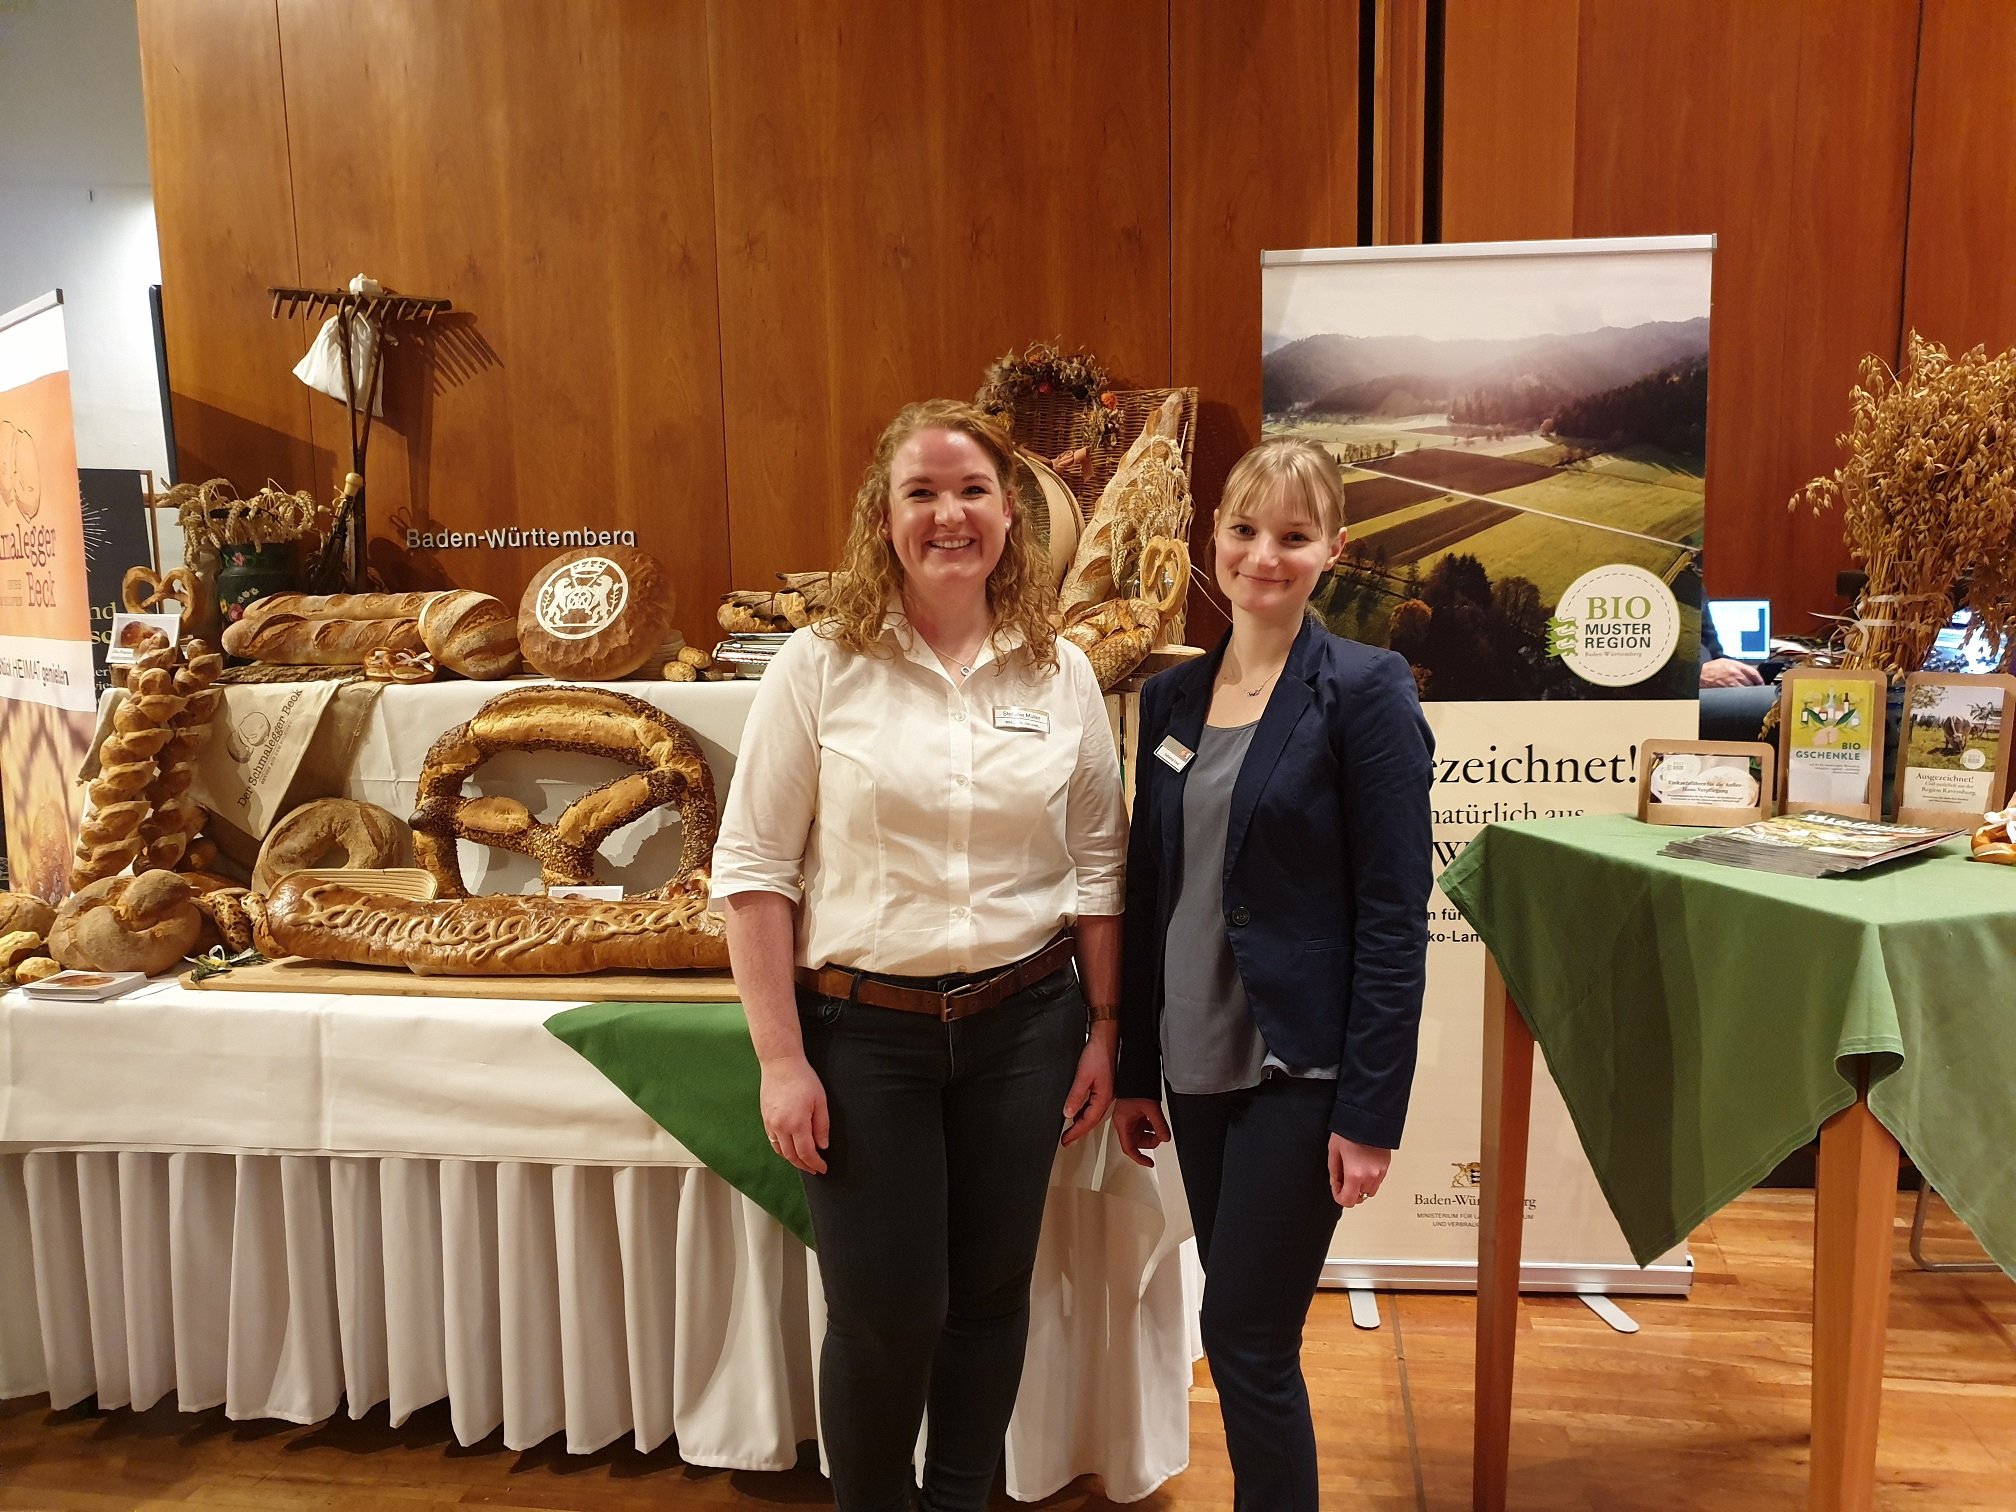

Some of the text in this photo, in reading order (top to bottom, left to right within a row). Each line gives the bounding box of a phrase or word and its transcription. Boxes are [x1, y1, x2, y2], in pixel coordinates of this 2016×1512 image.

[406, 527, 636, 549] Baden-Württemberg
[26, 570, 57, 608] Beck
[1586, 596, 1652, 620] BIO
[1585, 623, 1652, 636] MUSTER
[1585, 637, 1652, 649] REGION
[248, 716, 286, 787] Schmalegger
[1795, 750, 1861, 761] GSCHENKLE
[1916, 773, 1974, 783] Ausgezeichnet!
[1428, 930, 1480, 943] ko-Lan
